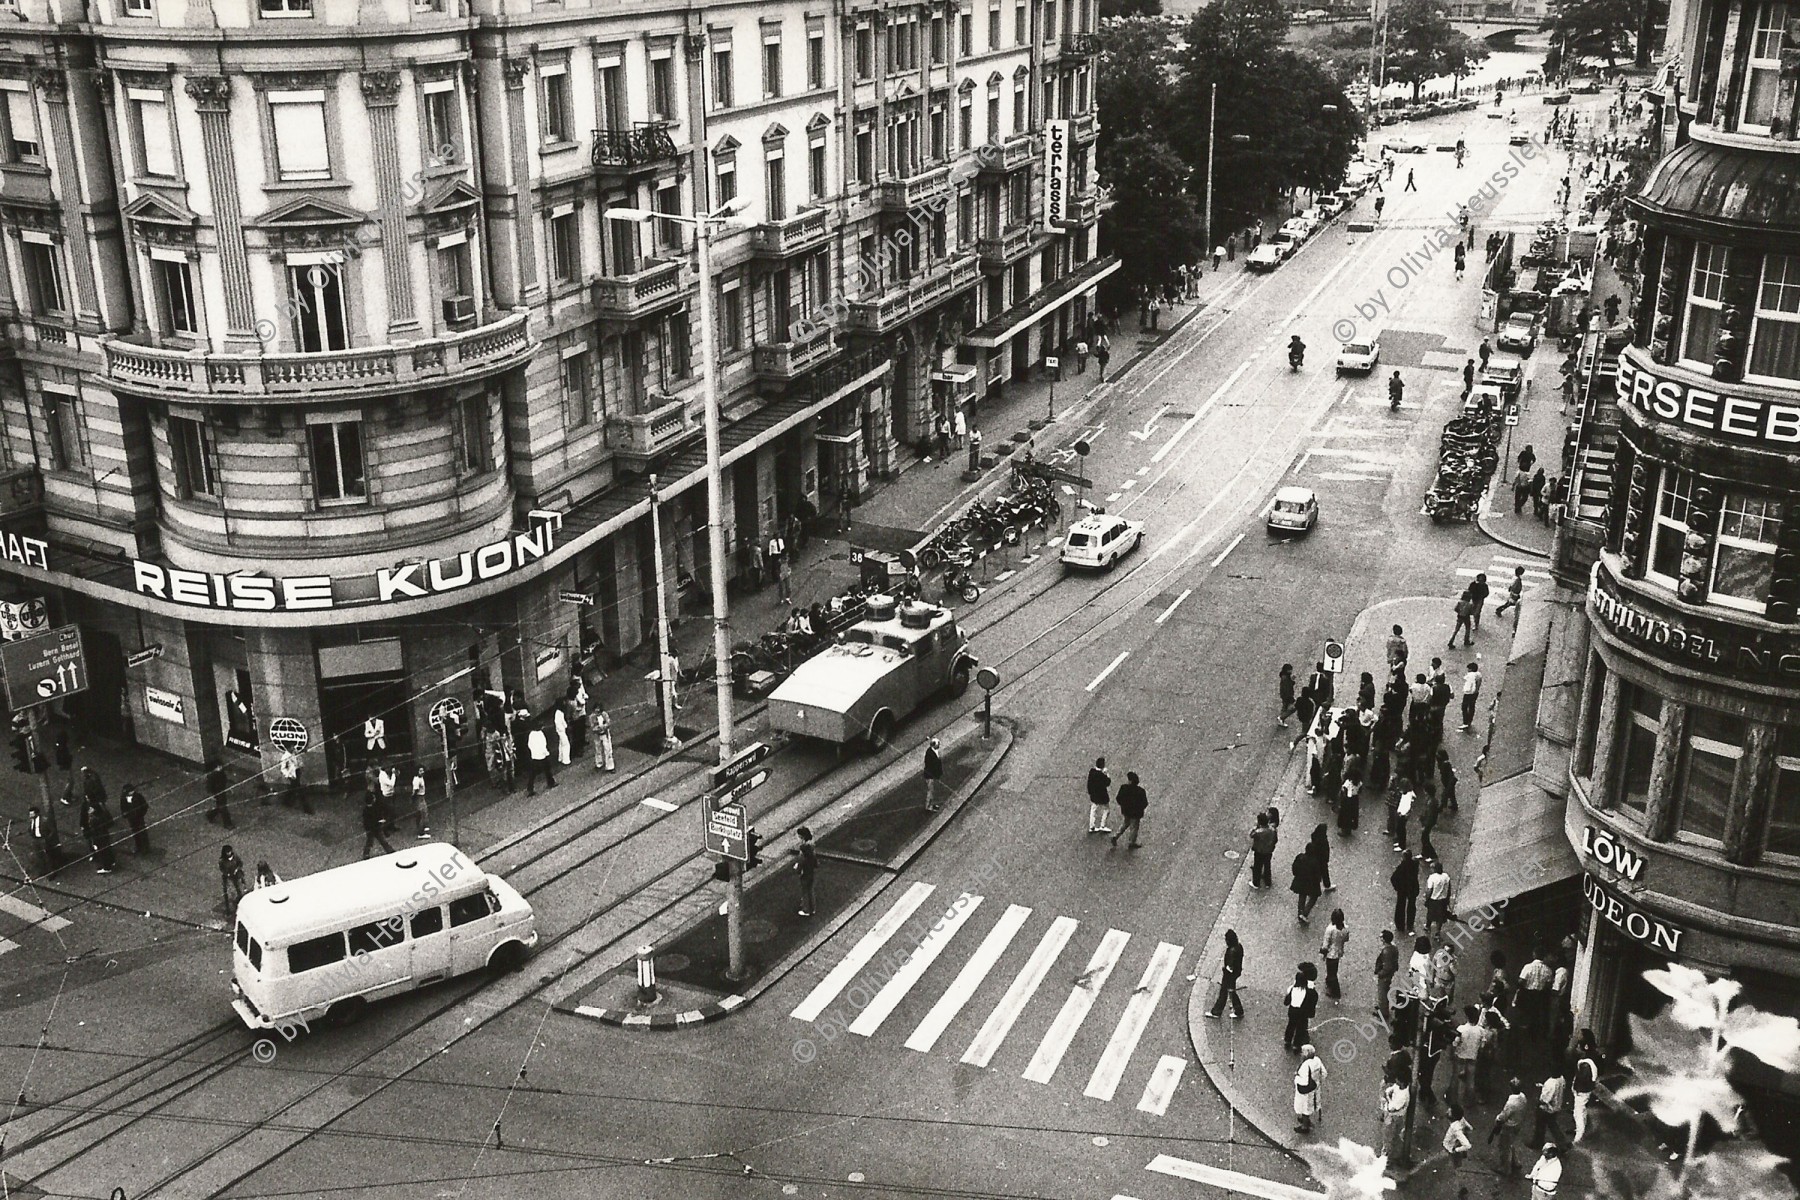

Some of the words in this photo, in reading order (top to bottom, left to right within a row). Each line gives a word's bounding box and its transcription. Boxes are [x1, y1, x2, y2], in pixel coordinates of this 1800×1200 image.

[943, 372, 953, 380] bar
[1509, 405, 1517, 415] P
[133, 559, 333, 610] REISE
[377, 521, 553, 601] KUONI
[1593, 588, 1722, 663] STAHLMÖBEL
[271, 732, 306, 740] KUONI
[1583, 872, 1683, 953] ODEON
